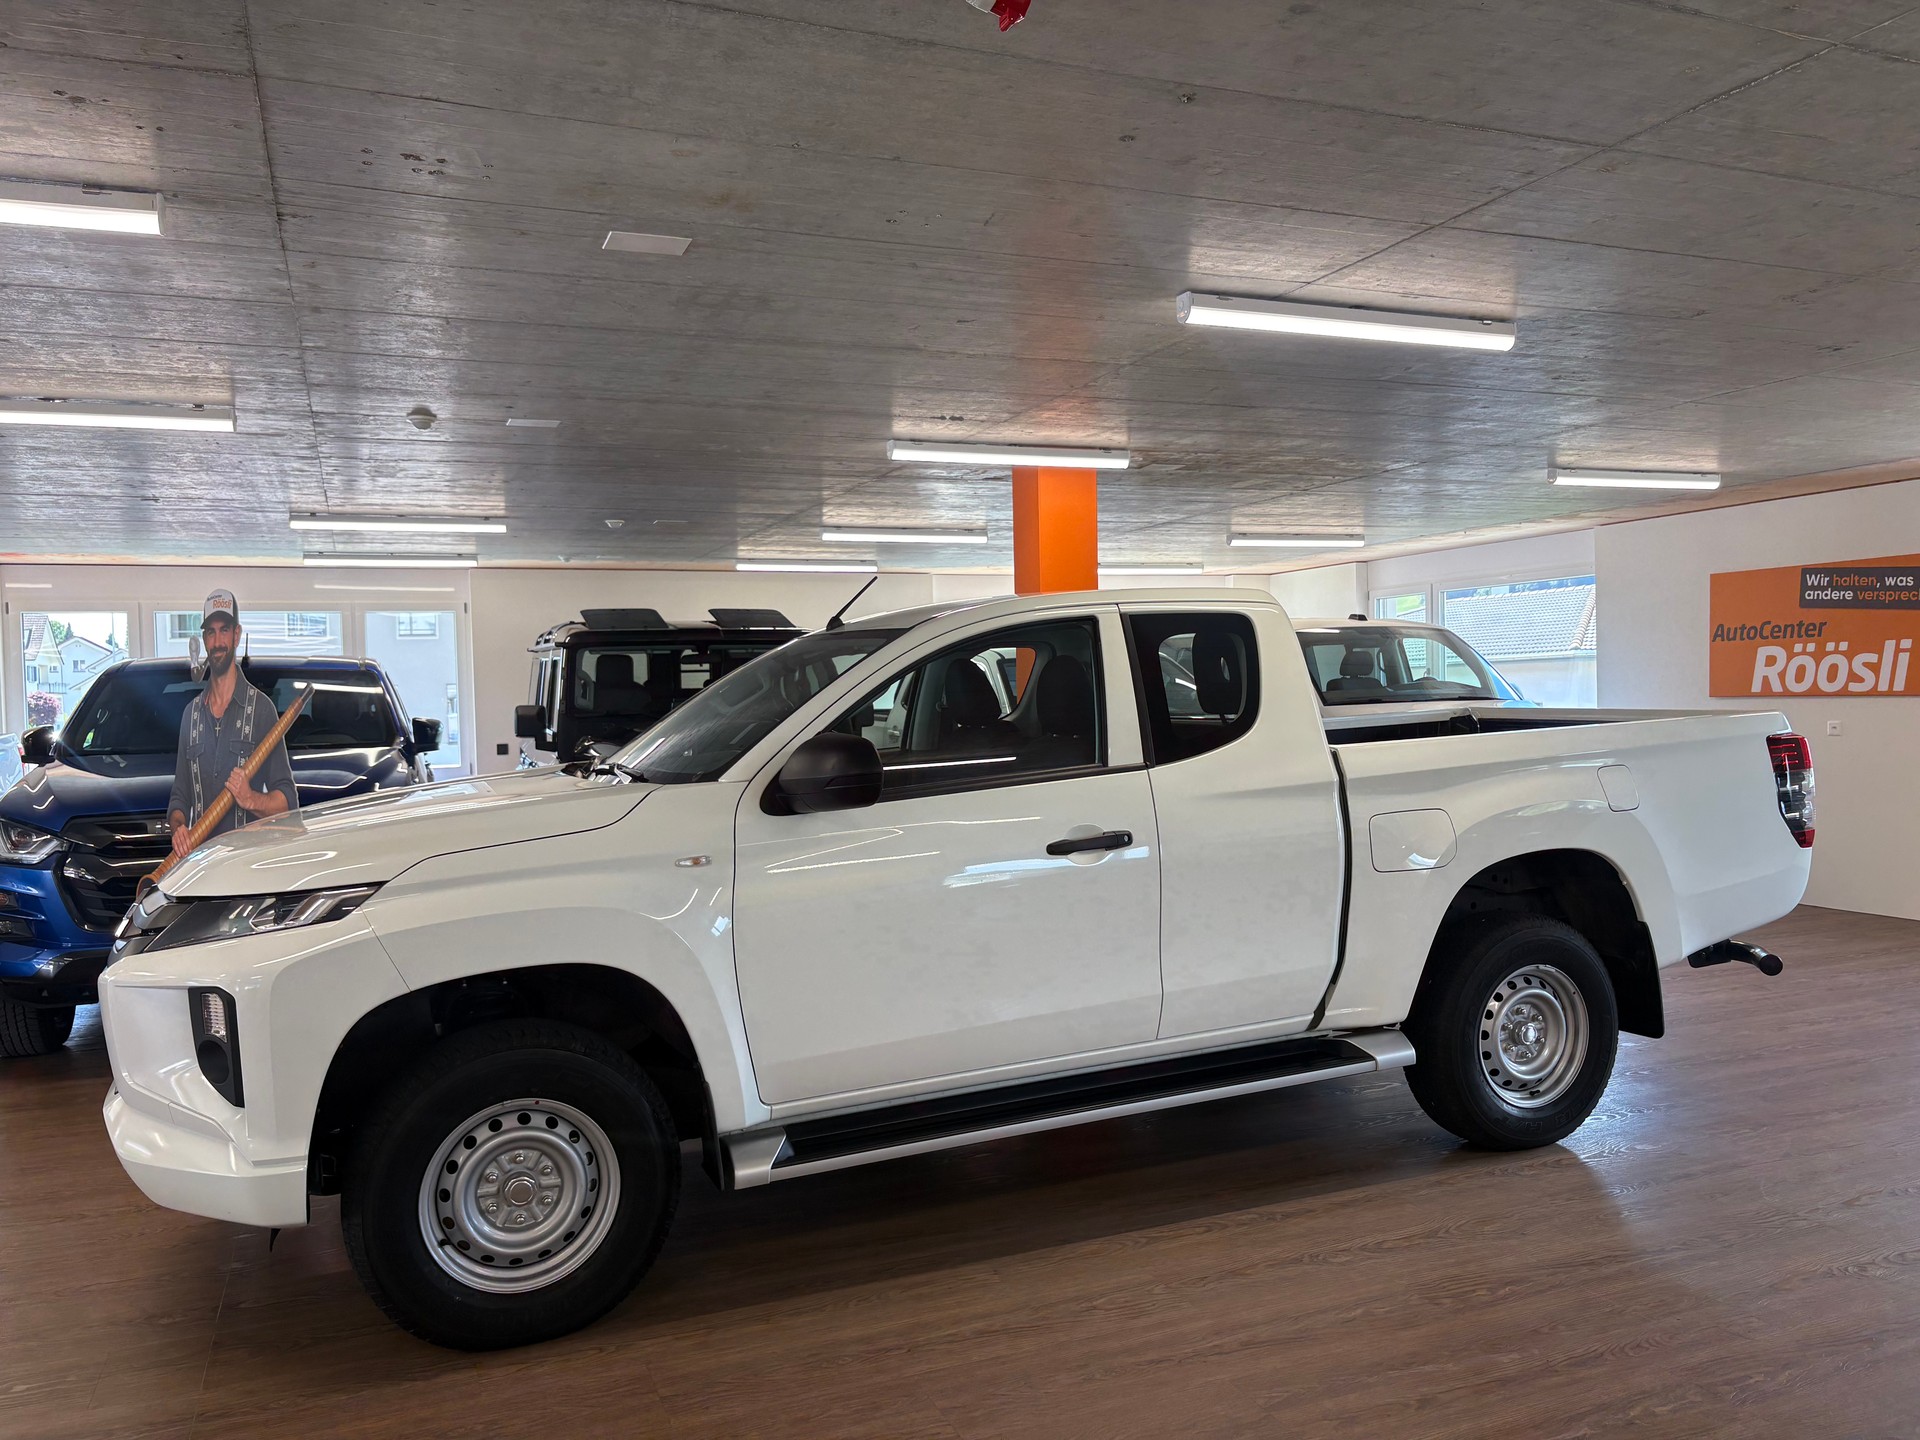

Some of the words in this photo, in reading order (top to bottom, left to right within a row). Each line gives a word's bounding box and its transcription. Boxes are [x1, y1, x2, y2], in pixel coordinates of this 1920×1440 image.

[1806, 574, 1829, 586] Wir
[1833, 574, 1880, 588] halten,
[1885, 576, 1914, 586] was
[1805, 588, 1853, 600] andere
[1712, 620, 1827, 642] AutoCenter
[1751, 639, 1912, 693] Röösli
